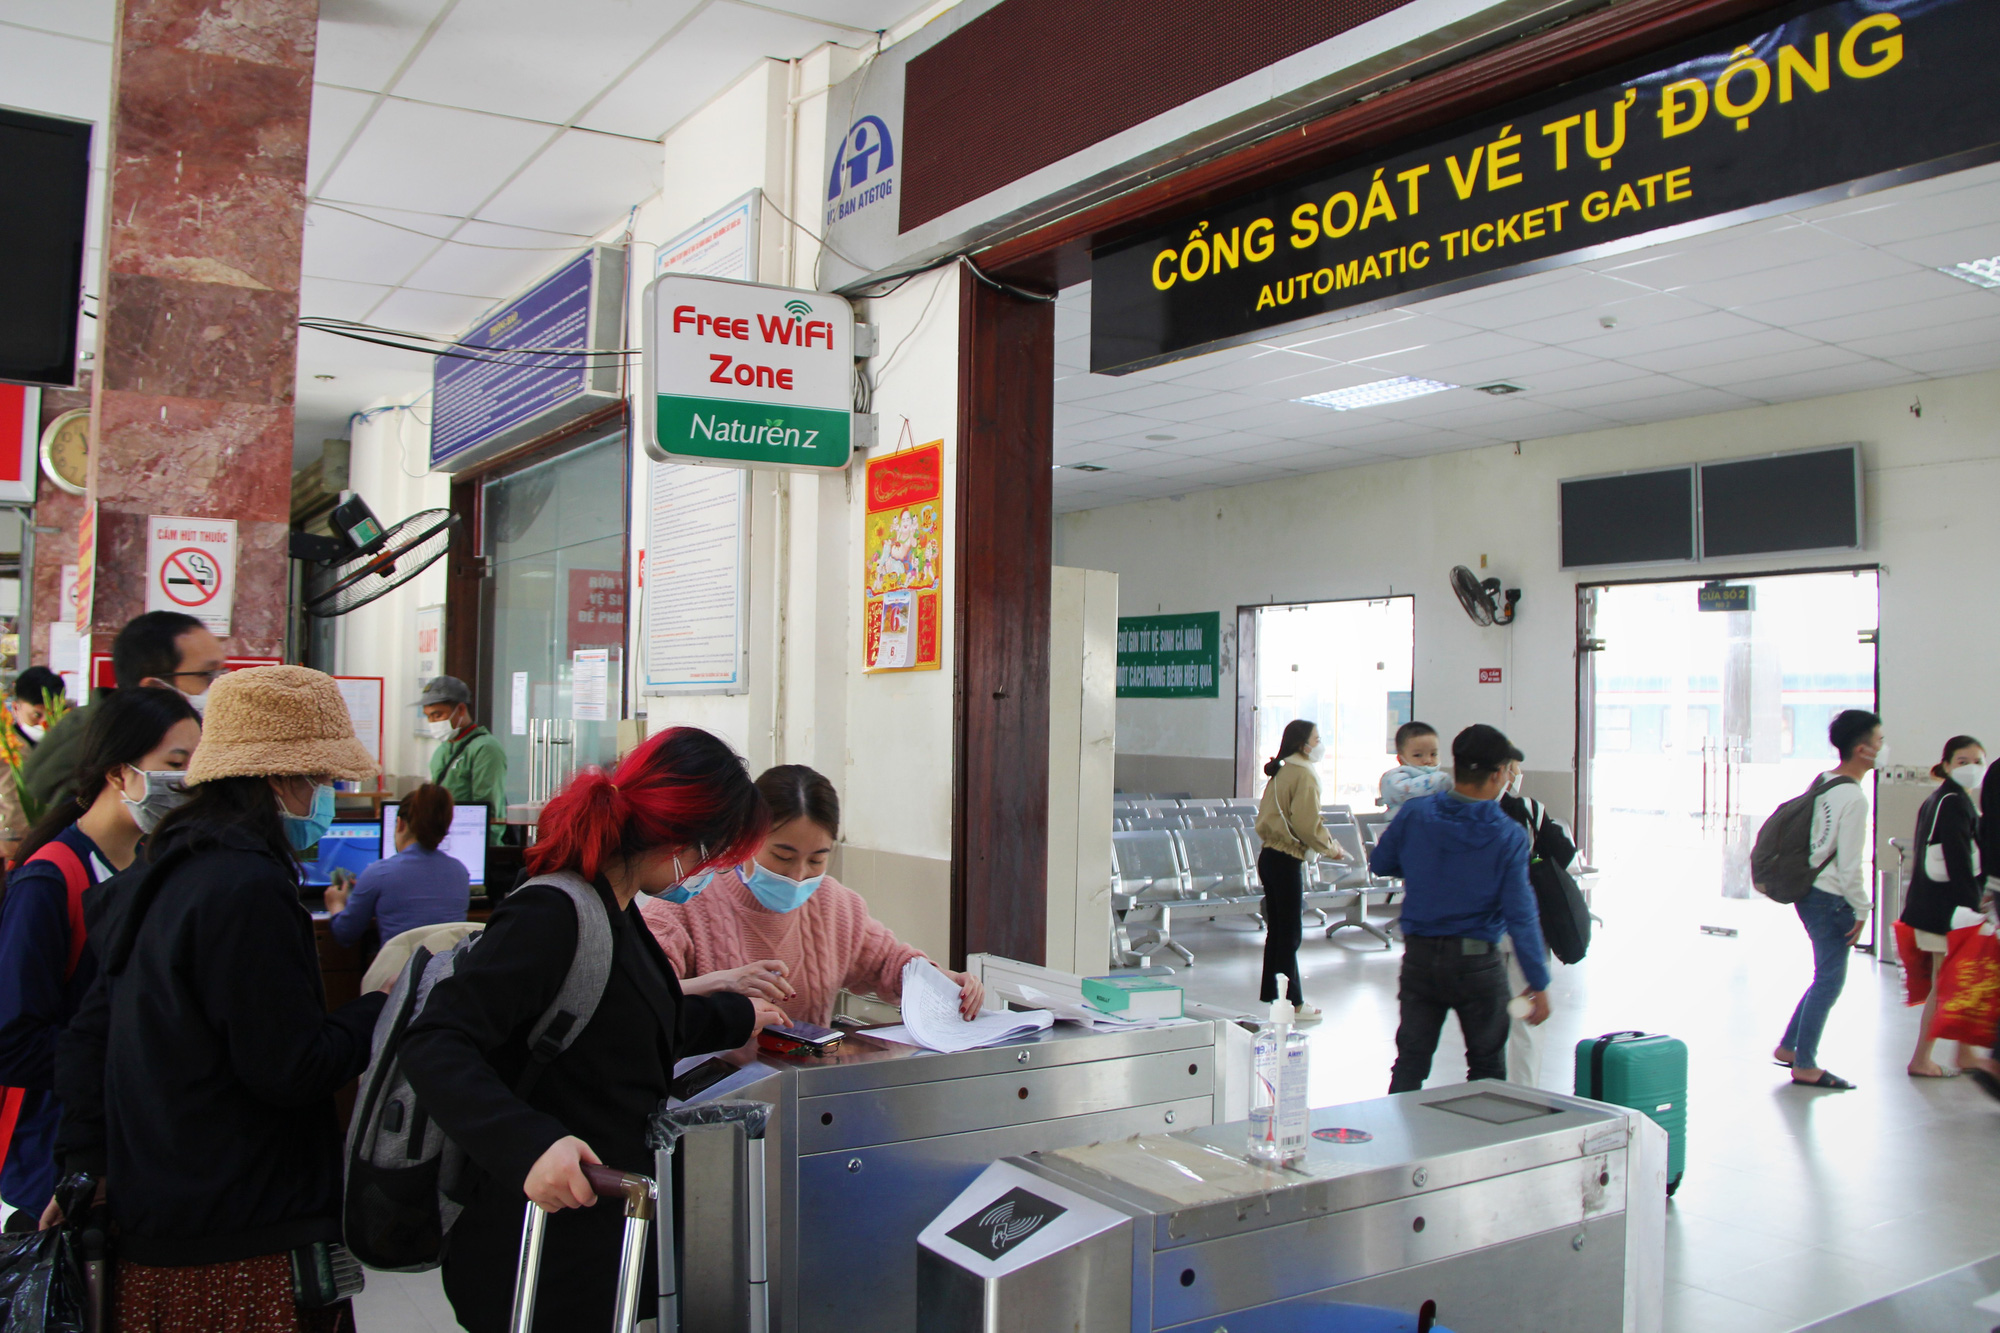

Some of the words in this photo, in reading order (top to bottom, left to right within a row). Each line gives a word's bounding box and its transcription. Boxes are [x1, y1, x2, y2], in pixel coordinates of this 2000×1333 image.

[1152, 219, 1275, 291] CỔNG
[1290, 164, 1430, 249] SOÁT
[1445, 125, 1523, 200] VÉ
[1542, 88, 1636, 171] TỰ
[1657, 13, 1904, 139] ĐỘNG
[839, 197, 856, 220] BAN
[858, 178, 892, 210] ATGTQG
[1255, 241, 1430, 311] AUTOMATIC
[1440, 200, 1569, 261] TICKET
[1581, 166, 1692, 223] GATE
[757, 314, 833, 350] WiFi
[709, 353, 793, 390] Zone
[157, 525, 178, 541] CẤM
[180, 527, 197, 541] HÚT
[1739, 590, 1745, 599] 2
[890, 606, 900, 632] 6
[890, 646, 895, 656] 6
